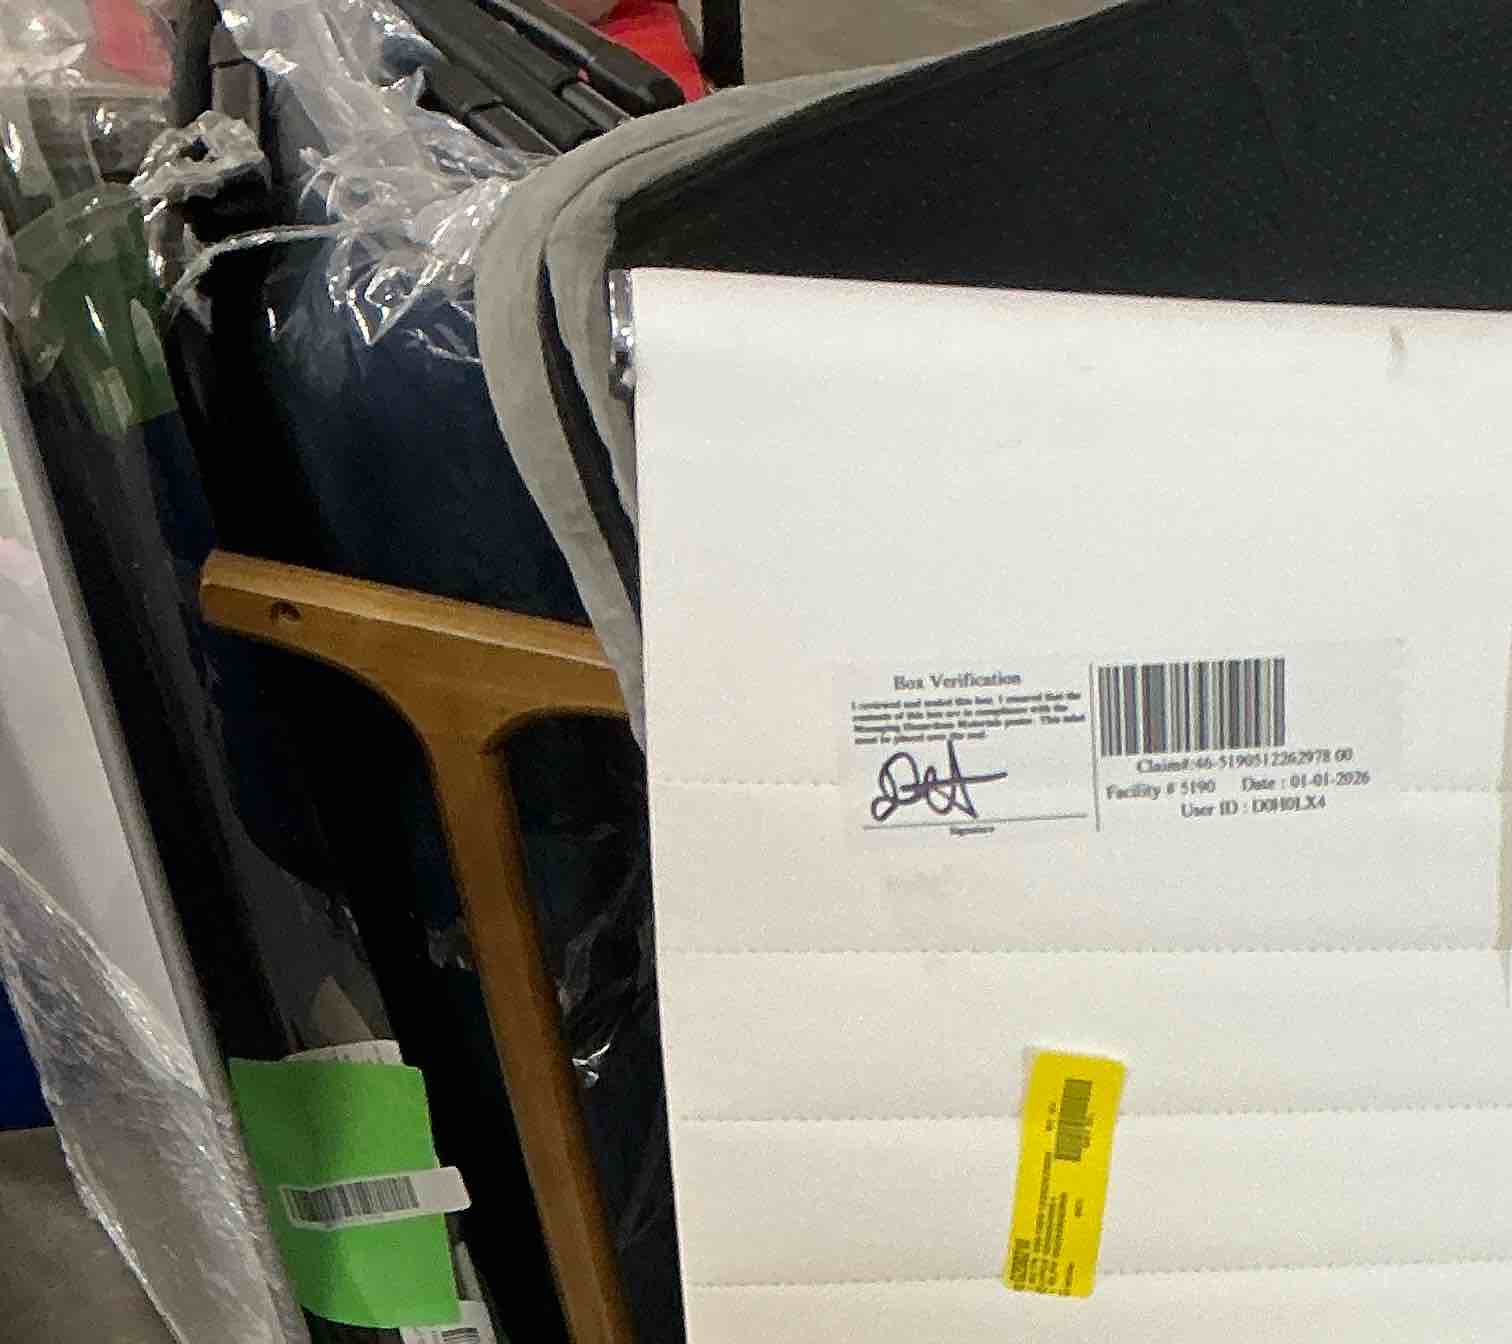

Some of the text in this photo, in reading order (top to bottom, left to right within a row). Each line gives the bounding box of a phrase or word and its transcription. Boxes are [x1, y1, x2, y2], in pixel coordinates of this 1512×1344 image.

[893, 671, 1023, 691] Box Verification
[1105, 783, 1161, 801] Facility
[1180, 778, 1217, 795] 5190
[1240, 776, 1277, 793] Date
[1179, 802, 1216, 818] User
[1218, 799, 1239, 816] ID
